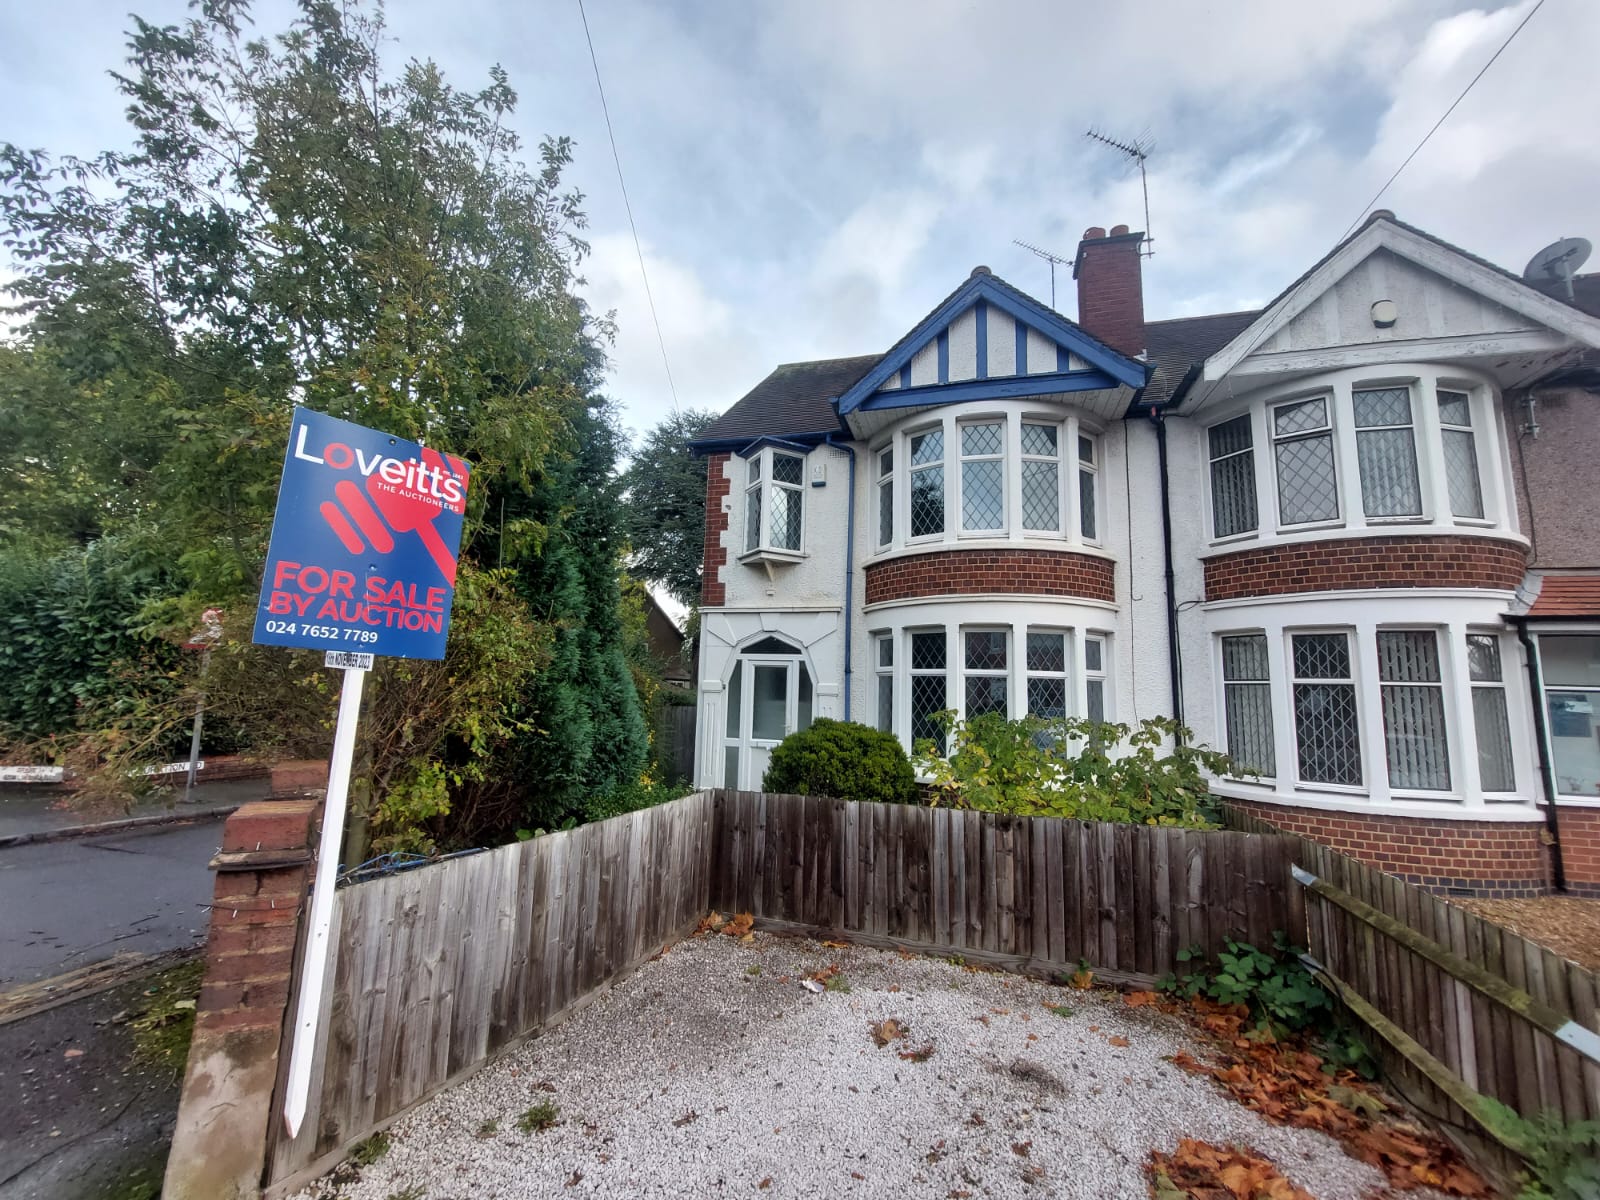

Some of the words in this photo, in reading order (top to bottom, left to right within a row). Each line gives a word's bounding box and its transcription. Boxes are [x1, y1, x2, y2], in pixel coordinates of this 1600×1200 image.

[295, 424, 462, 503] Loveitts
[377, 481, 397, 494] THE
[399, 489, 460, 512] AUCTIONEERS
[273, 560, 357, 599] FOR
[363, 576, 447, 613] SALE
[265, 620, 297, 635] 024
[301, 623, 339, 640] 7652
[343, 628, 378, 644] 7789
[269, 590, 316, 617] BY
[316, 598, 443, 634] AUCTION
